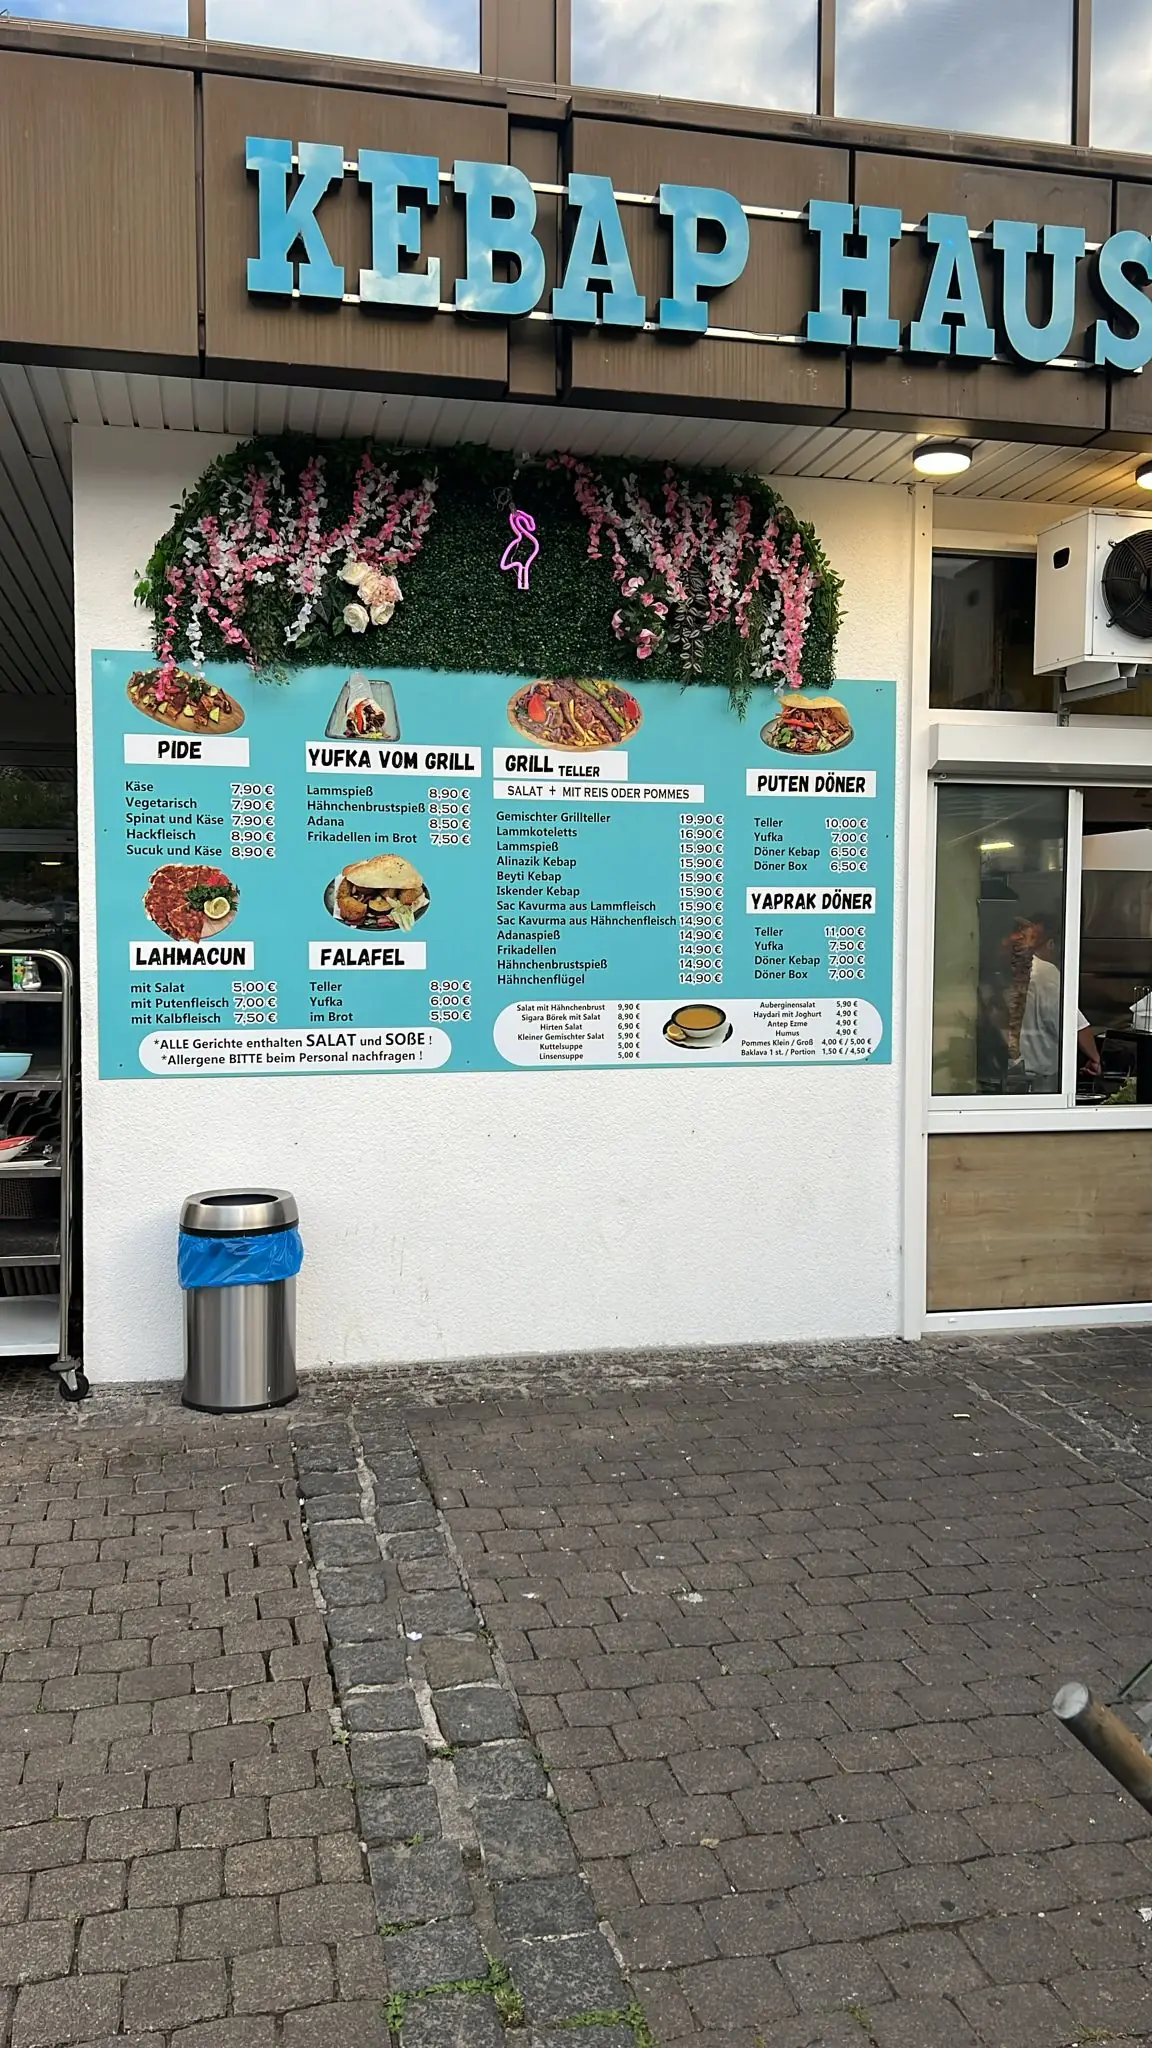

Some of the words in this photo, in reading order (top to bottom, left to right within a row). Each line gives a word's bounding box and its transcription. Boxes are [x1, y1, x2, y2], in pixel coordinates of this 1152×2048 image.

[246, 136, 749, 332] KEBAP
[807, 199, 1152, 370] HAUS
[158, 740, 202, 760] PIDE
[308, 748, 372, 768] YUFKA
[378, 750, 418, 770] VOM
[425, 752, 475, 771] GRILL
[505, 754, 554, 773] GRILL
[558, 765, 600, 777] TELLER
[125, 781, 154, 792] Käse
[757, 775, 809, 793] PUTEN
[815, 771, 866, 793] DÖNER
[307, 784, 374, 799] Lammspieß
[507, 785, 543, 797] SALAT
[562, 786, 582, 797] MIT
[584, 787, 609, 798] REIS
[611, 787, 641, 799] ODER
[644, 788, 690, 799] POMMES
[125, 796, 197, 811] Vegetarisch
[307, 800, 426, 816] Hähnchenbrustspieß
[126, 812, 166, 827] Spinat
[168, 813, 192, 825] und
[196, 814, 224, 825] Käse
[307, 815, 344, 827] Adana
[496, 810, 558, 822] Gemischter
[560, 812, 611, 823] Grillteller
[753, 817, 784, 828] Teller
[126, 828, 196, 840] Hackfleisch
[307, 830, 371, 843] Frikadellen
[374, 832, 389, 843] im
[392, 833, 417, 844] Brot
[496, 826, 578, 837] Lammkoteletts
[753, 831, 783, 842] Yufka
[126, 844, 164, 856] Sucuk
[167, 844, 191, 856] und
[194, 845, 222, 857] Käse
[497, 841, 559, 854] Lammspieß
[754, 846, 786, 857] Döner
[788, 846, 820, 859] Kebap
[496, 855, 540, 867] Alinazik
[543, 856, 577, 870] Kebap
[754, 860, 786, 871] Döner
[788, 861, 808, 871] Box
[497, 870, 524, 884] Beyti
[528, 870, 562, 884] Kebap
[496, 885, 544, 896] Iskender
[546, 885, 580, 899] Kebap
[751, 893, 817, 910] YAPRAK
[821, 888, 872, 910] DÖNER
[496, 900, 515, 911] Sac
[518, 900, 566, 911] Kavurma
[569, 903, 588, 911] aus
[590, 900, 656, 911] Lammfleisch
[496, 915, 516, 926] Sac
[518, 915, 566, 926] Kavurma
[569, 918, 588, 926] aus
[590, 915, 677, 926] Hähnchenfleisch
[496, 929, 561, 943] Adanaspieß
[754, 926, 784, 937] Teller
[497, 944, 557, 955] Frikadellen
[754, 940, 784, 951] Yufka
[136, 947, 246, 966] LAHMACUN
[320, 948, 405, 966] FALAFEL
[754, 955, 786, 965] Döner
[788, 954, 821, 967] Kebap
[497, 958, 608, 972] Hähnchenbrustspieß
[497, 973, 585, 987] Hähnchenflügel
[754, 969, 786, 979] Döner
[788, 969, 808, 979] Box
[130, 982, 152, 993] mit
[154, 982, 185, 993] Salat
[309, 981, 343, 992] Teller
[131, 998, 152, 1009] mit
[155, 997, 229, 1009] Putenfleisch
[309, 996, 343, 1007] Yufka
[516, 1004, 535, 1012] Salat
[550, 1003, 605, 1011] Hähnchenbrust
[759, 1001, 816, 1011] Auberginensalat
[131, 1013, 152, 1024] mit
[155, 1012, 221, 1024] Kalbfleisch
[310, 1011, 325, 1022] im
[328, 1011, 353, 1022] Brot
[521, 1014, 545, 1023] Sigara
[546, 1013, 568, 1021] Börek
[568, 1013, 582, 1021] mit
[582, 1013, 601, 1021] Salat
[753, 1010, 781, 1020] Haydari
[781, 1010, 794, 1018] mit
[794, 1010, 822, 1020] Joghurt
[540, 1023, 563, 1031] Hirten
[564, 1023, 583, 1031] Salat
[767, 1020, 789, 1029] Antep
[517, 1033, 544, 1041] Kleiner
[544, 1032, 586, 1041] Gemischter
[586, 1032, 605, 1040] Salat
[775, 1029, 800, 1037] Humus
[192, 1038, 243, 1049] Gerichte
[246, 1037, 303, 1048] enthalten
[306, 1033, 357, 1047] SALAT
[360, 1035, 382, 1046] und
[539, 1042, 583, 1052] Kuttelsuppe
[741, 1039, 771, 1047] Pommes
[796, 1038, 814, 1046] Groß
[229, 1053, 263, 1064] BITTE
[266, 1052, 295, 1063] beim
[299, 1051, 348, 1063] Personal
[352, 1050, 415, 1064] nachfragen
[539, 1052, 584, 1061] Linsensuppe
[741, 1048, 768, 1056] Baklava
[790, 1048, 816, 1056] Portion
